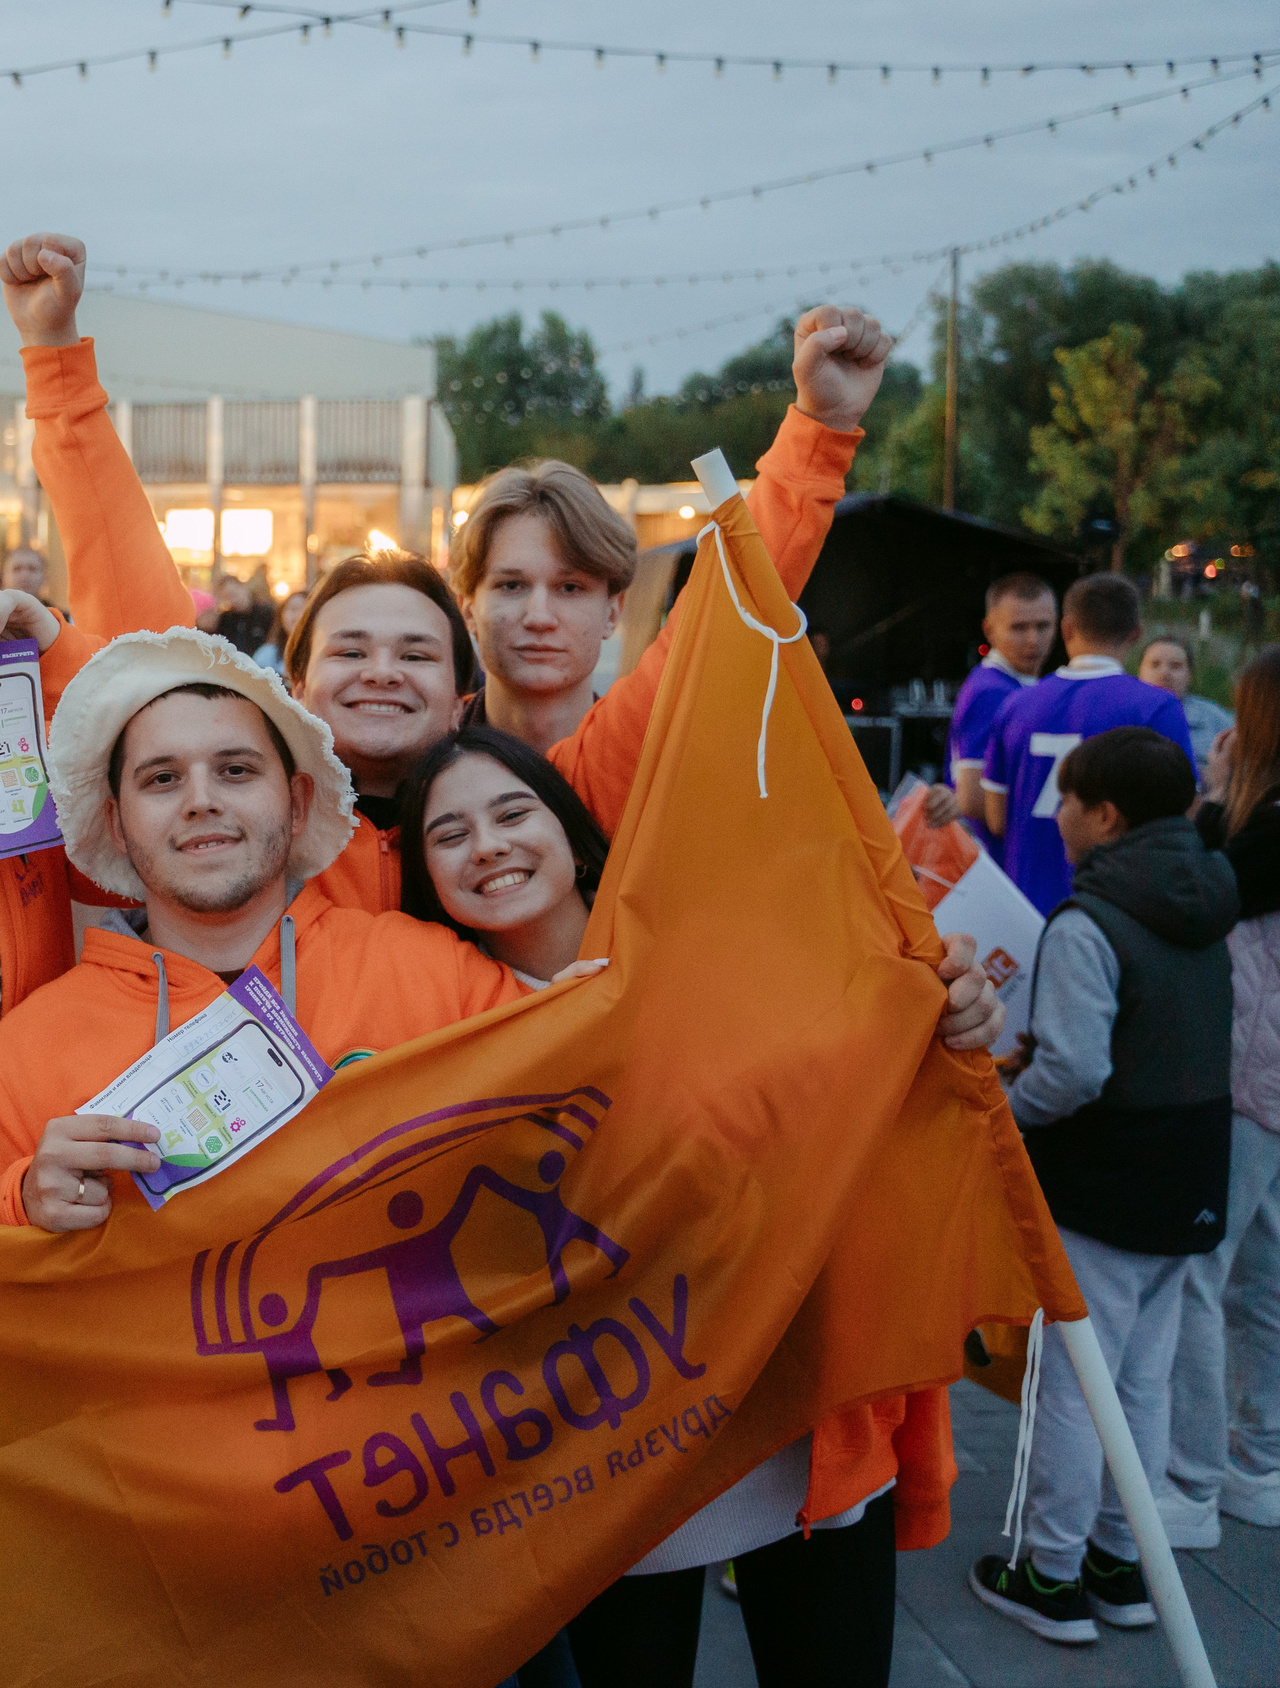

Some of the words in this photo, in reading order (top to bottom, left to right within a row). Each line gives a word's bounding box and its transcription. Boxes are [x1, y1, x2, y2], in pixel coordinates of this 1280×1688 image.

[1029, 732, 1082, 818] 7
[253, 976, 273, 999] ПРОЙДИ
[166, 1030, 184, 1043] Номер
[184, 1013, 207, 1030] телефона
[266, 1012, 274, 1021] ОТ
[271, 1009, 302, 1050] ВОЗМОЖНОСТЬ
[301, 1050, 323, 1082] ВЫИГРАТЬ
[90, 1089, 113, 1110] Фамилия
[116, 1078, 127, 1088] имя
[125, 1054, 153, 1080] владельца
[255, 1080, 264, 1088] 17
[260, 1087, 274, 1104] АВГУСТА
